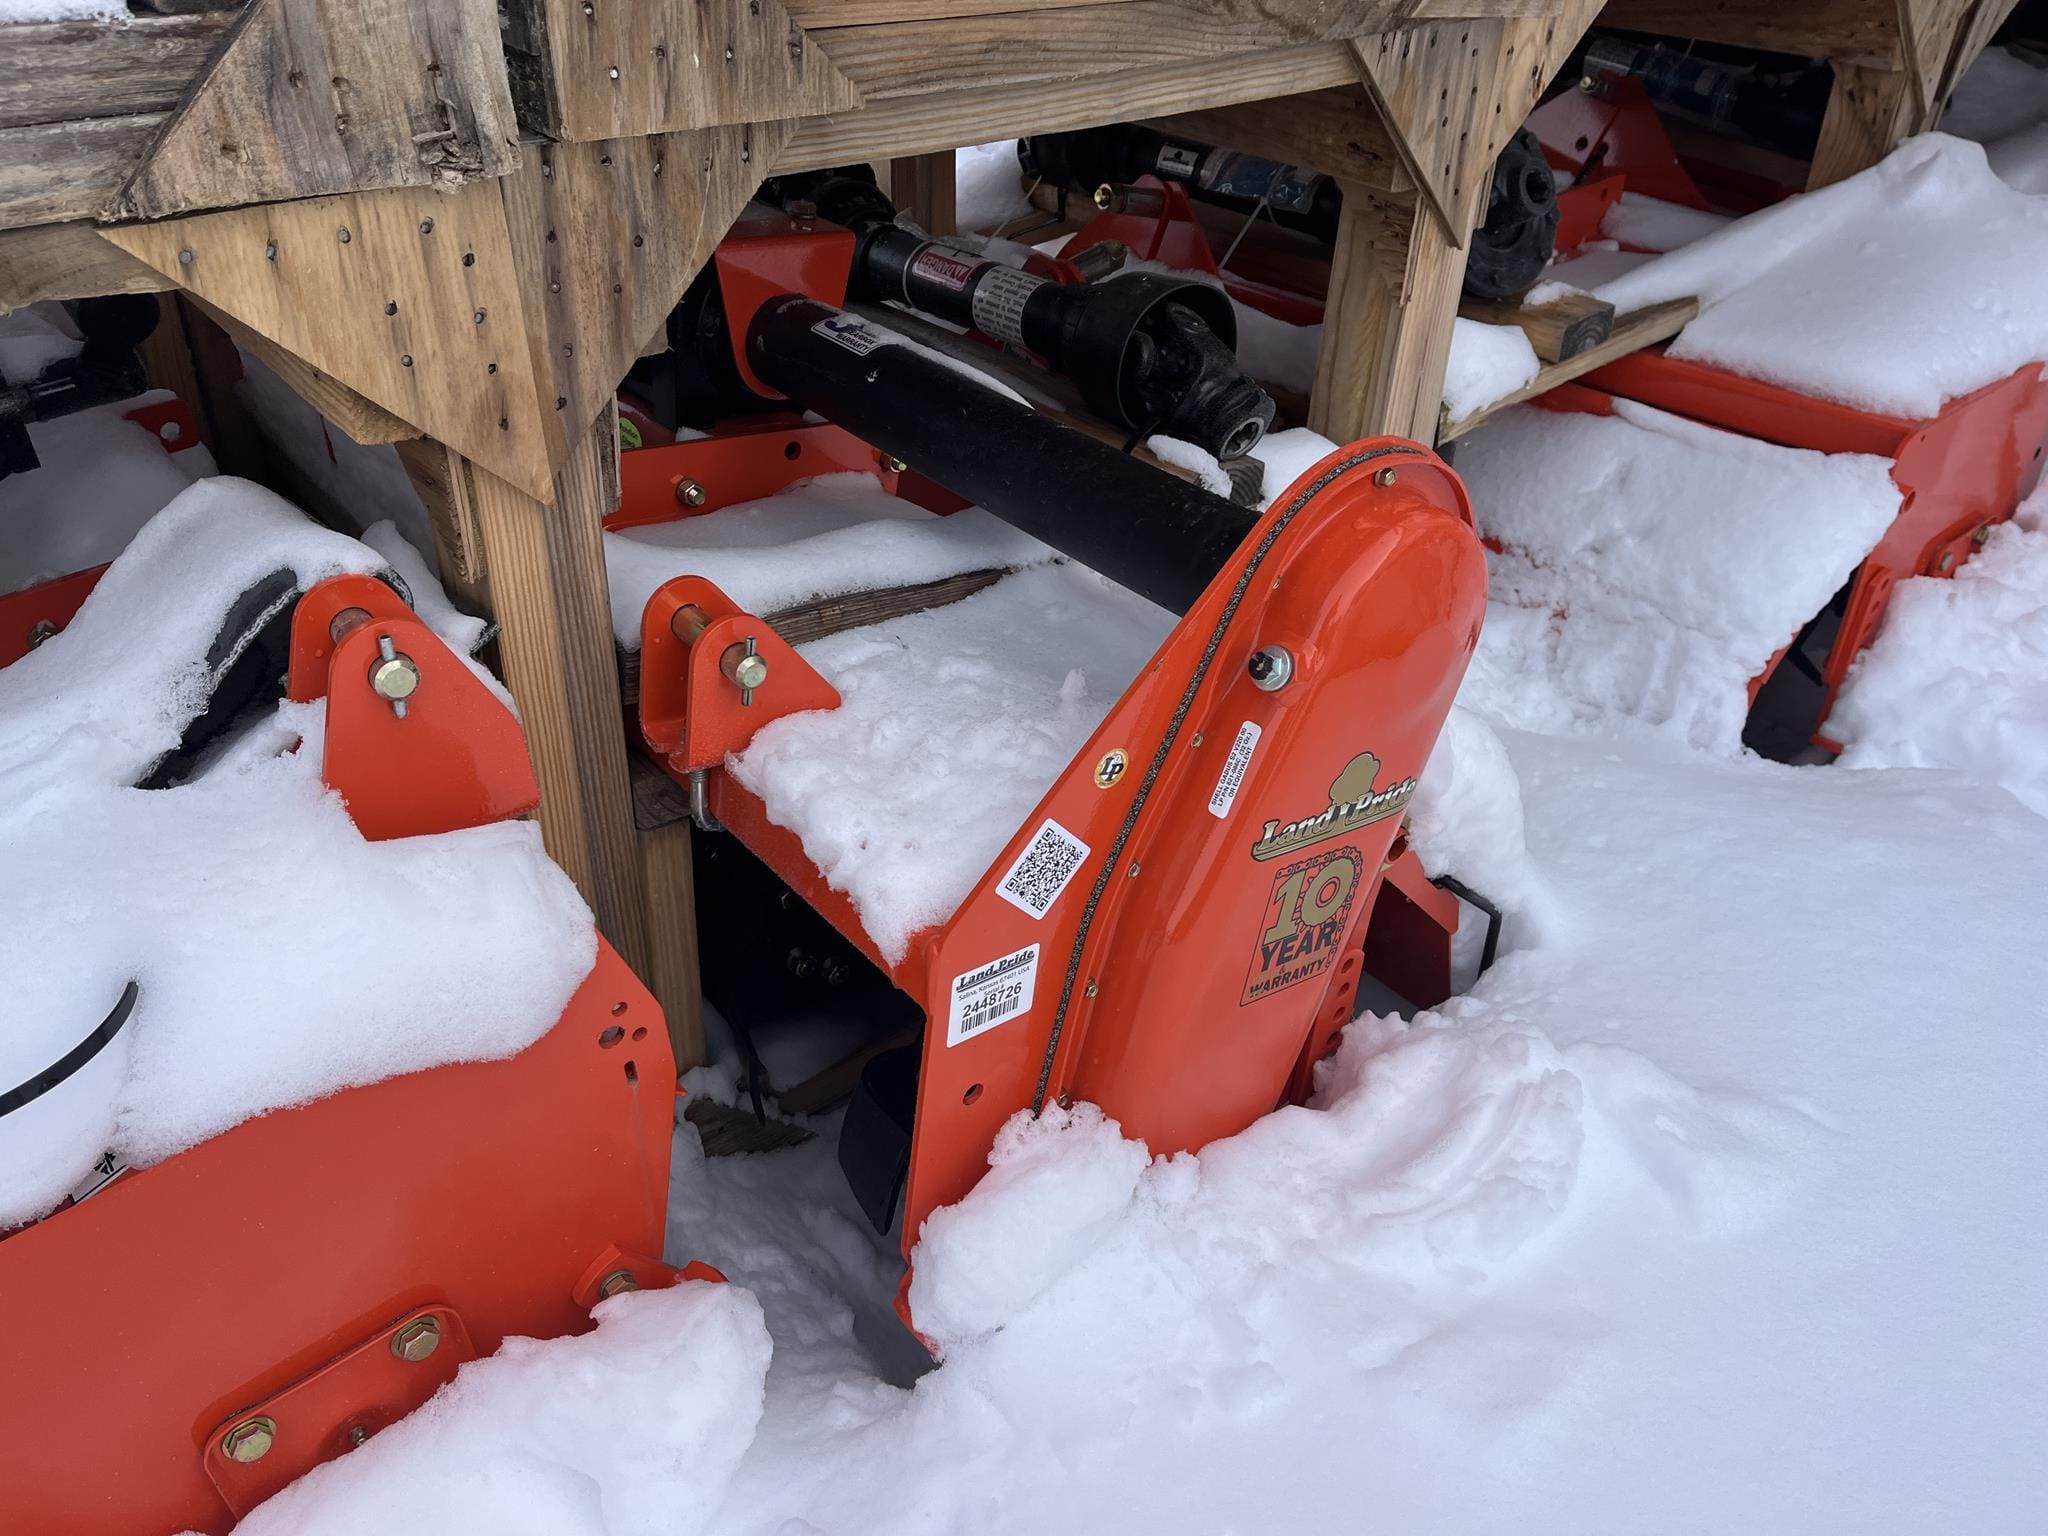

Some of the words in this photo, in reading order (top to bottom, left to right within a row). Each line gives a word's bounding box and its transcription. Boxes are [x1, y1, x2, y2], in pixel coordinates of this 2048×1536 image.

[1211, 785, 1224, 806] SHELL
[1221, 761, 1234, 785] GADUS
[1228, 787, 1236, 798] OR
[1233, 746, 1253, 788] EQUIVALENT
[1217, 797, 1224, 807] LP
[1255, 802, 1338, 851] Land
[1262, 856, 1357, 946] 10
[1261, 920, 1338, 973] YEAR
[956, 964, 995, 991] Land
[998, 950, 1035, 972] Pride
[978, 980, 999, 992] Kansas
[1017, 965, 1030, 975] USA
[1248, 957, 1327, 998] WARRANTY
[962, 981, 1022, 1019] 2448726
[983, 986, 1001, 997] Serial
